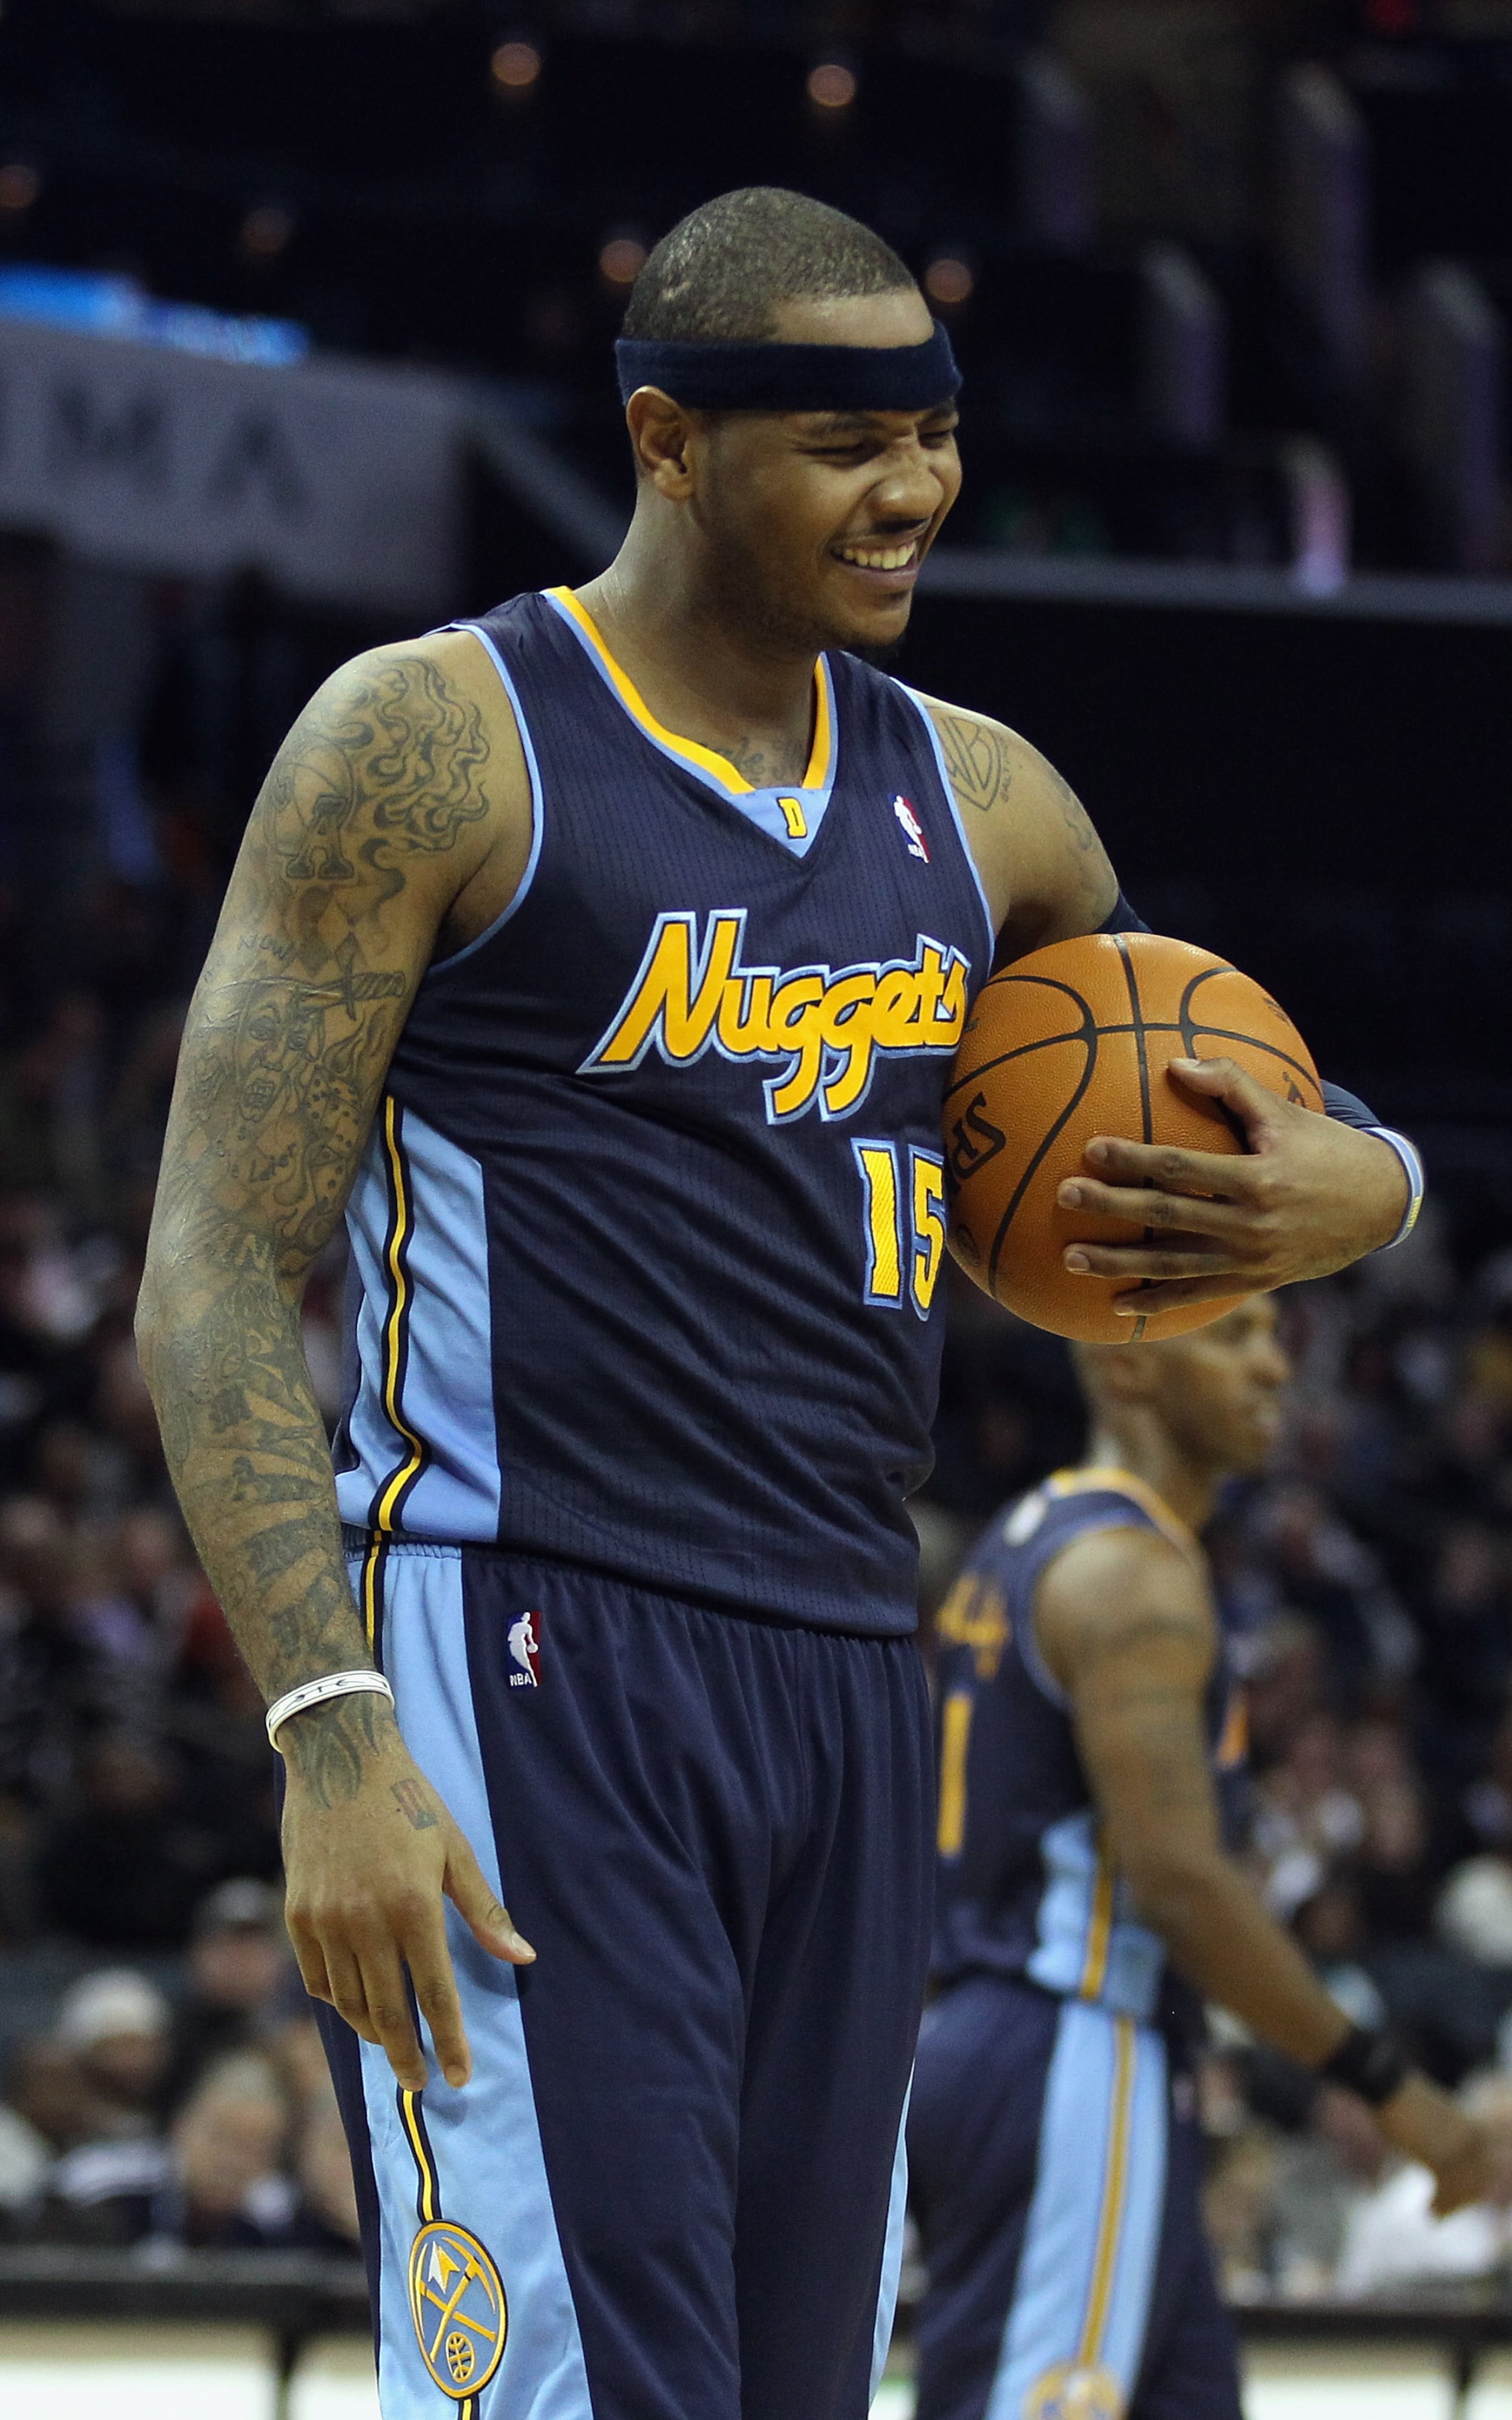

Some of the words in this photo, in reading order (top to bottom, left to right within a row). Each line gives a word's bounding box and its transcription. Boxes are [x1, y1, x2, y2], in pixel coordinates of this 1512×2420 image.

[0, 365, 313, 535] MA
[777, 797, 807, 839] D
[575, 908, 971, 1126] Nuggets
[850, 1137, 946, 1322] 15
[509, 1672, 532, 1687] NBA
